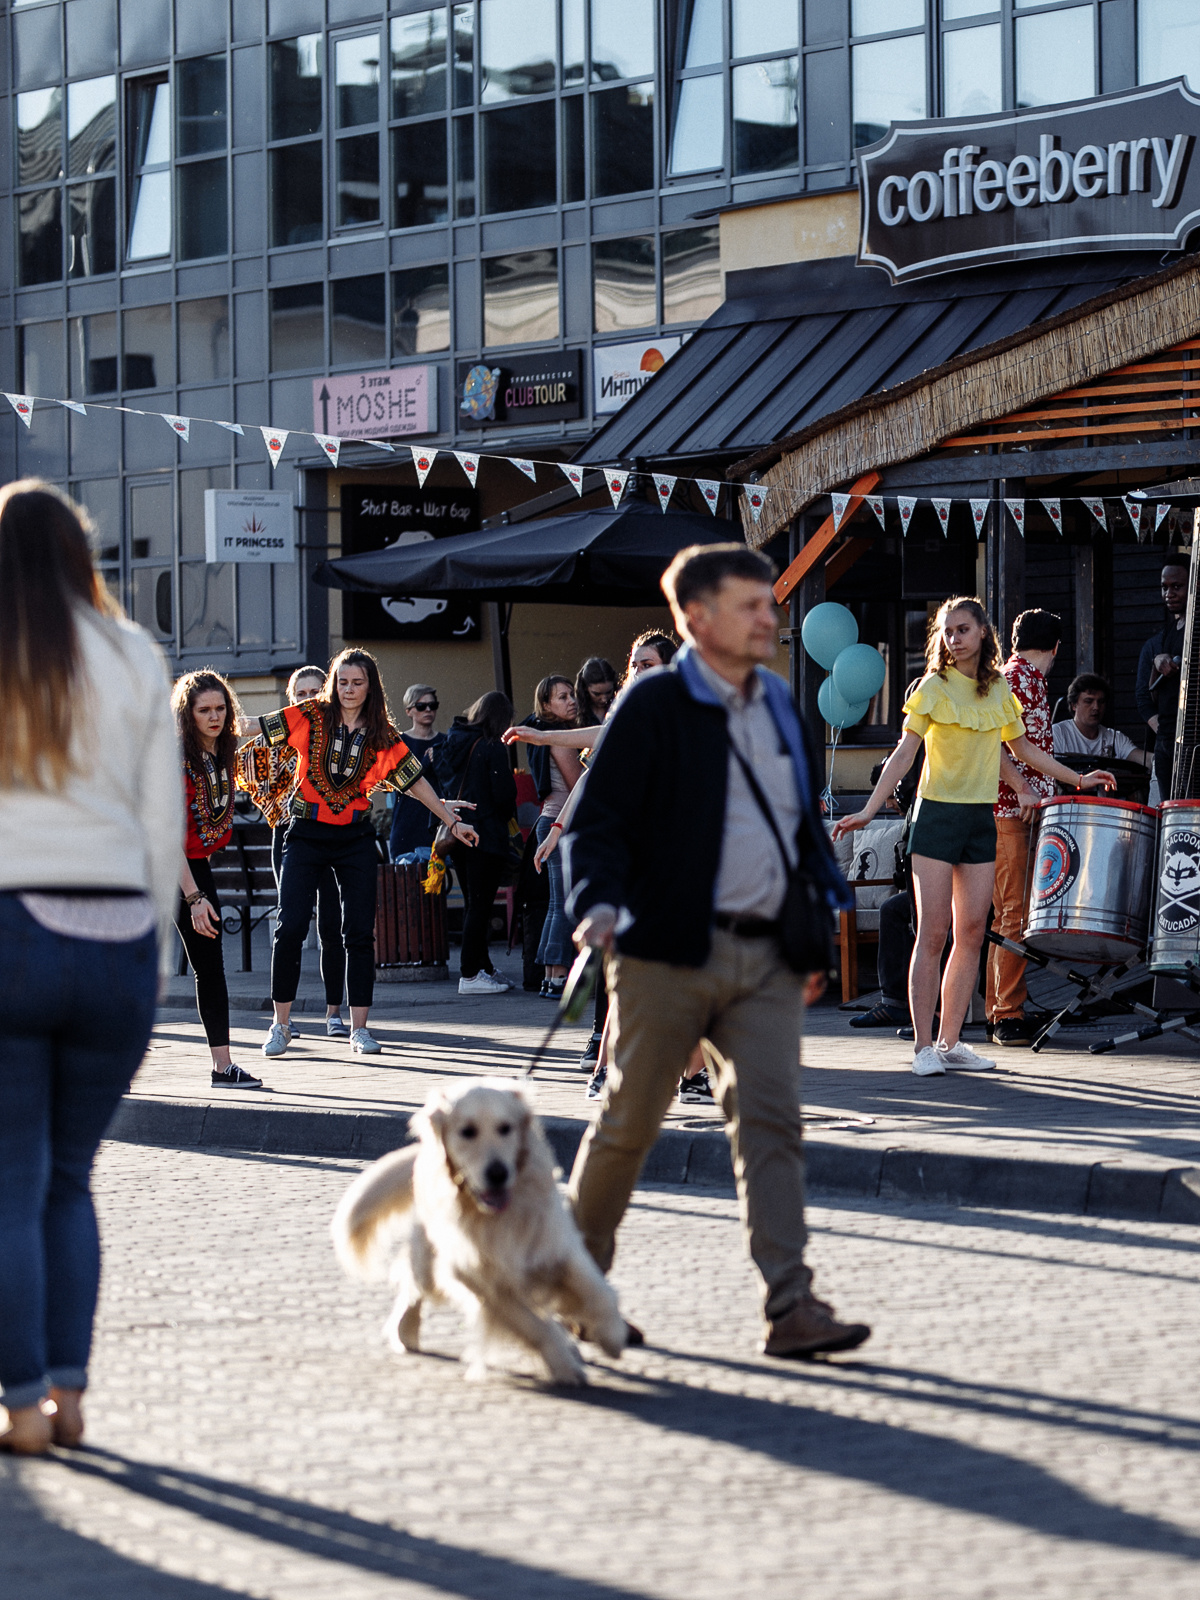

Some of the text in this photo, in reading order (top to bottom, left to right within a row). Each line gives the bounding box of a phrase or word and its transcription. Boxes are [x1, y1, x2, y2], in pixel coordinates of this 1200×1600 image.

[877, 133, 1191, 226] coffeeberry
[360, 375, 391, 389] 3 этаж
[601, 375, 652, 398] Инту
[336, 387, 416, 425] MOSHE
[505, 382, 567, 408] CLUBTOUR
[360, 499, 388, 515] Shot
[423, 502, 448, 517] Шот
[450, 503, 471, 521] бар
[224, 537, 285, 549] IT PRINCESS
[1158, 914, 1197, 931] BATUCADA
